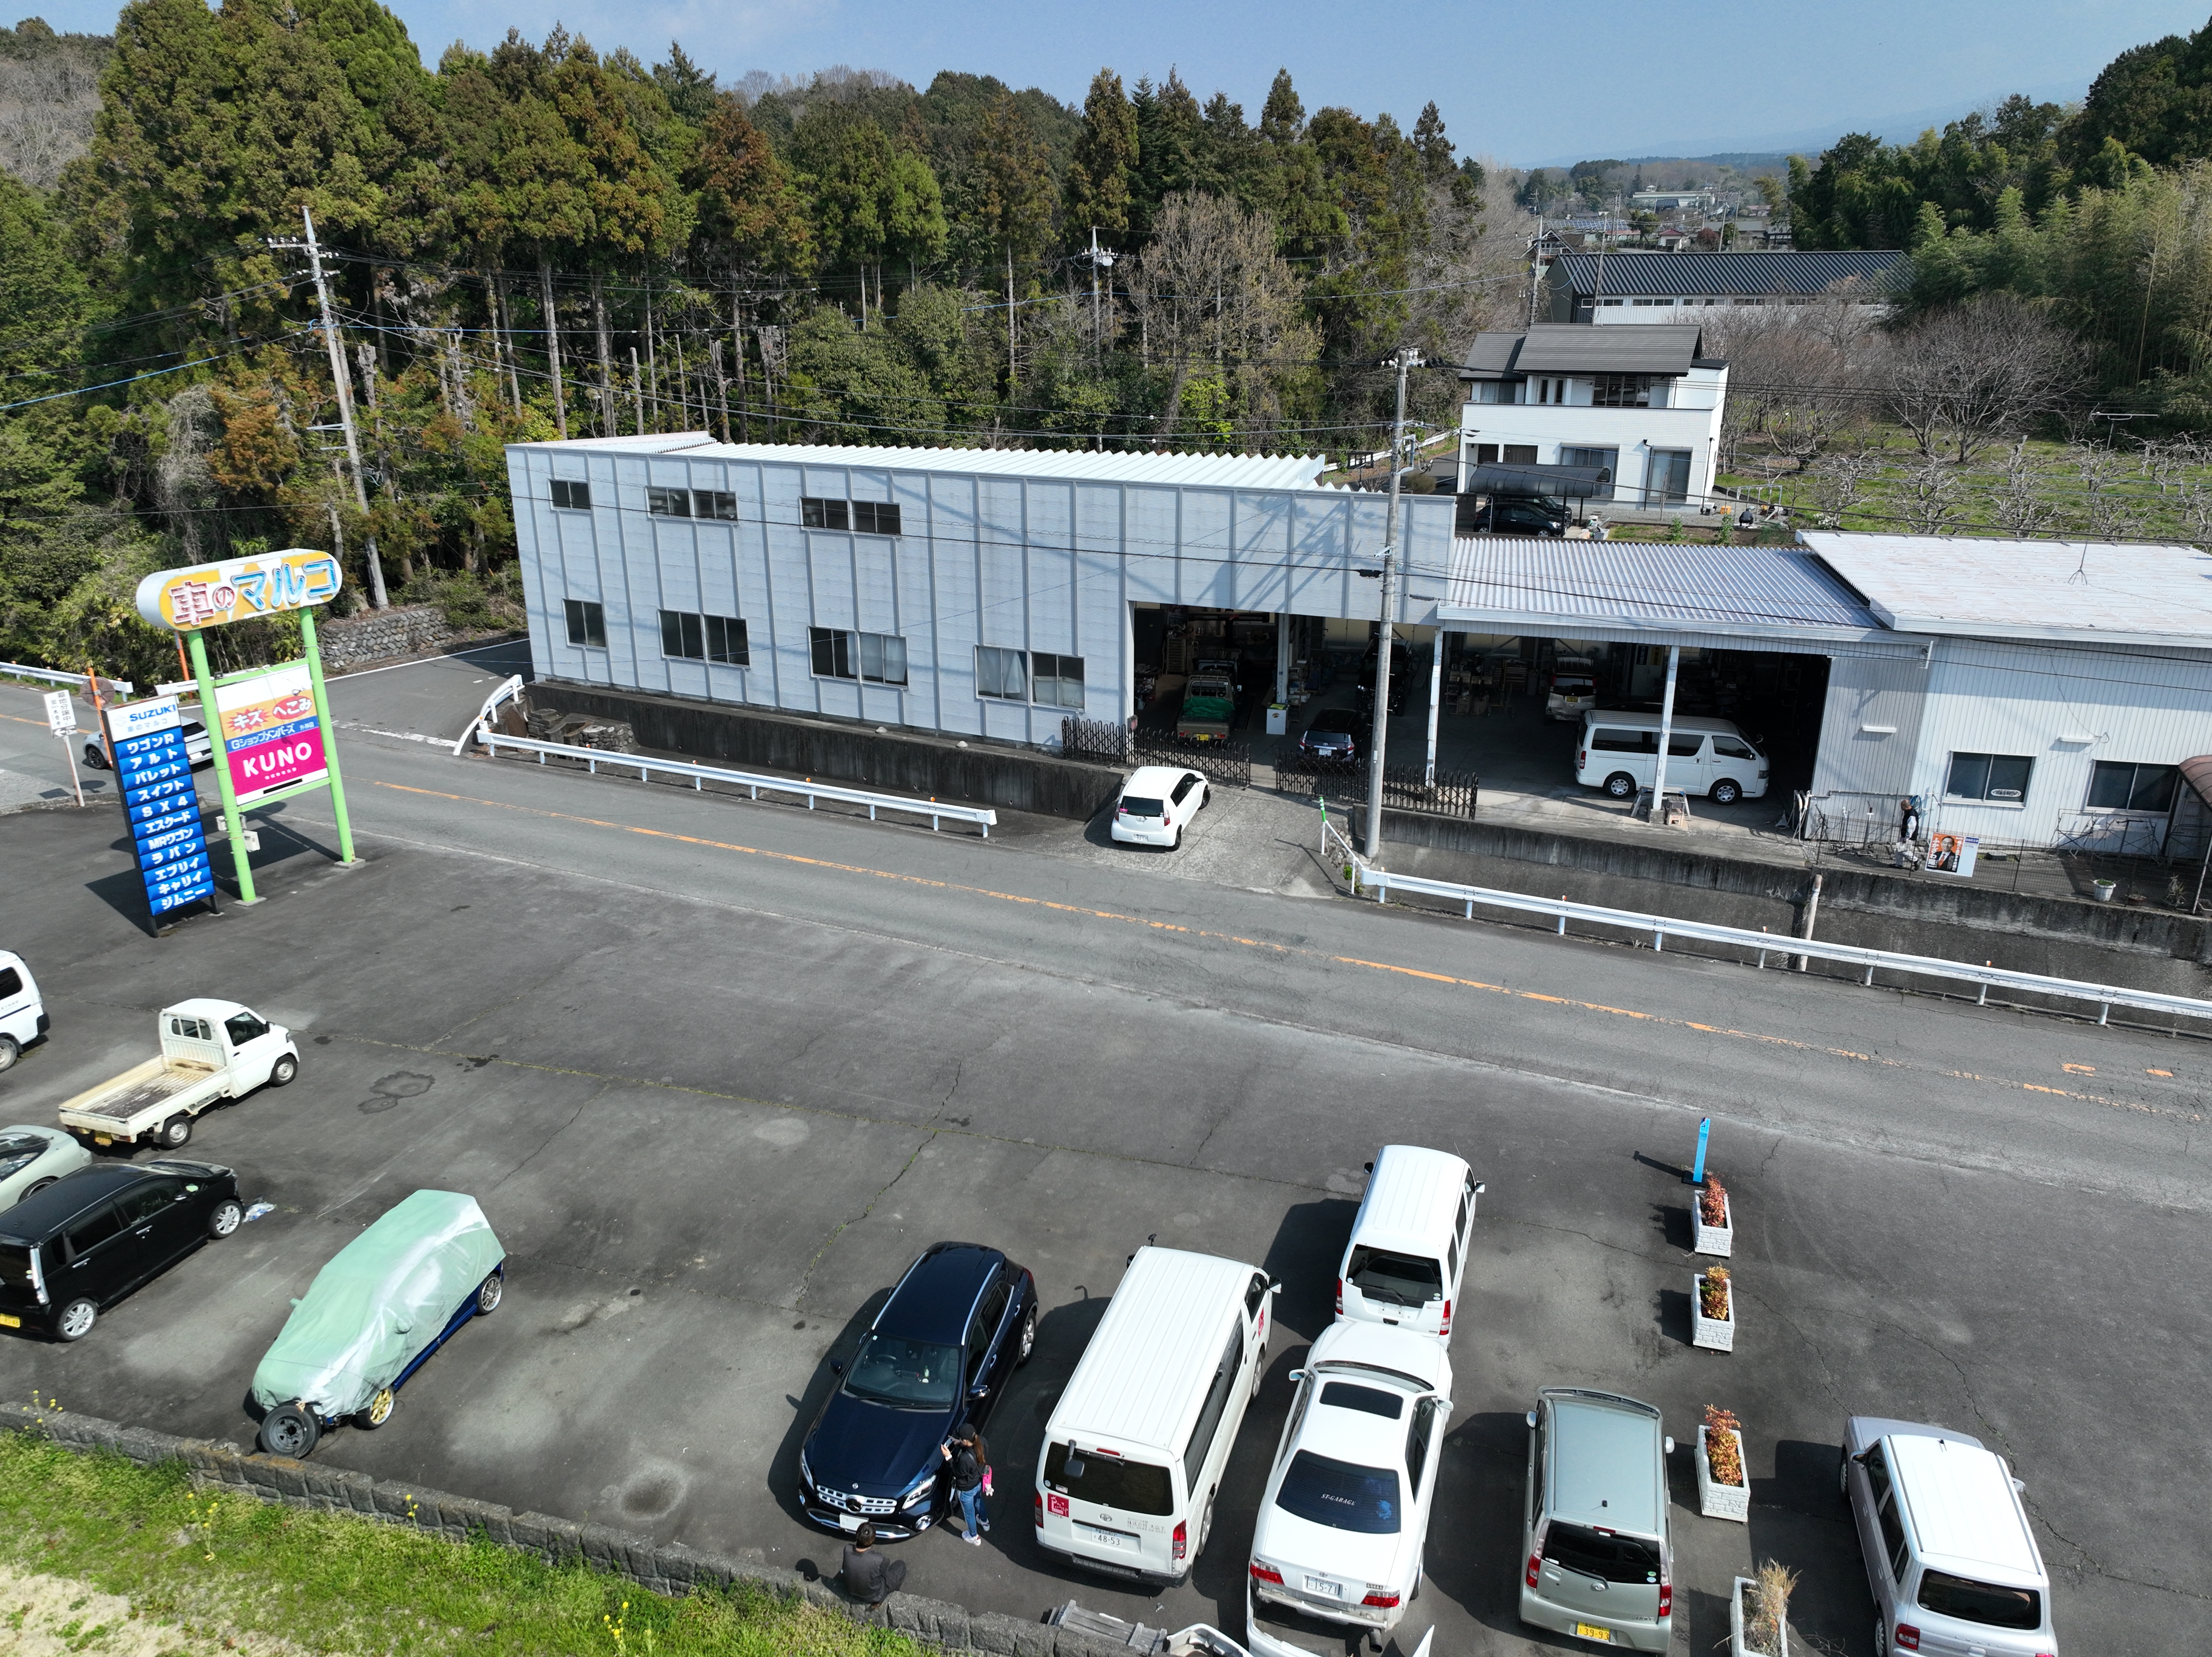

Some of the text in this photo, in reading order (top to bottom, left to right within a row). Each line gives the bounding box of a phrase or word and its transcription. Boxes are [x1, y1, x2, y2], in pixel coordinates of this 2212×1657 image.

[169, 559, 338, 625] 車のマルコ
[129, 704, 176, 722] SUZUKI
[233, 697, 312, 728] キズ へこみ
[127, 718, 168, 732] 車のマルコ
[231, 723, 295, 749] Gショップメンバーズ
[127, 733, 175, 754] ワゴンR
[130, 748, 178, 769] アルト
[243, 742, 312, 777] KUNO
[135, 764, 181, 785] パレット
[138, 780, 184, 801] スイフト
[145, 810, 191, 834] エスクード
[148, 828, 194, 850] MRワゴン
[152, 842, 196, 865] ラパン
[155, 857, 199, 881] エブリイ
[159, 871, 202, 894] キャリイ
[161, 888, 207, 910] ジムニー
[1098, 1534, 1120, 1545] 48-53
[1315, 1581, 1336, 1594] 15-71
[1584, 1627, 1609, 1640] 39-93
